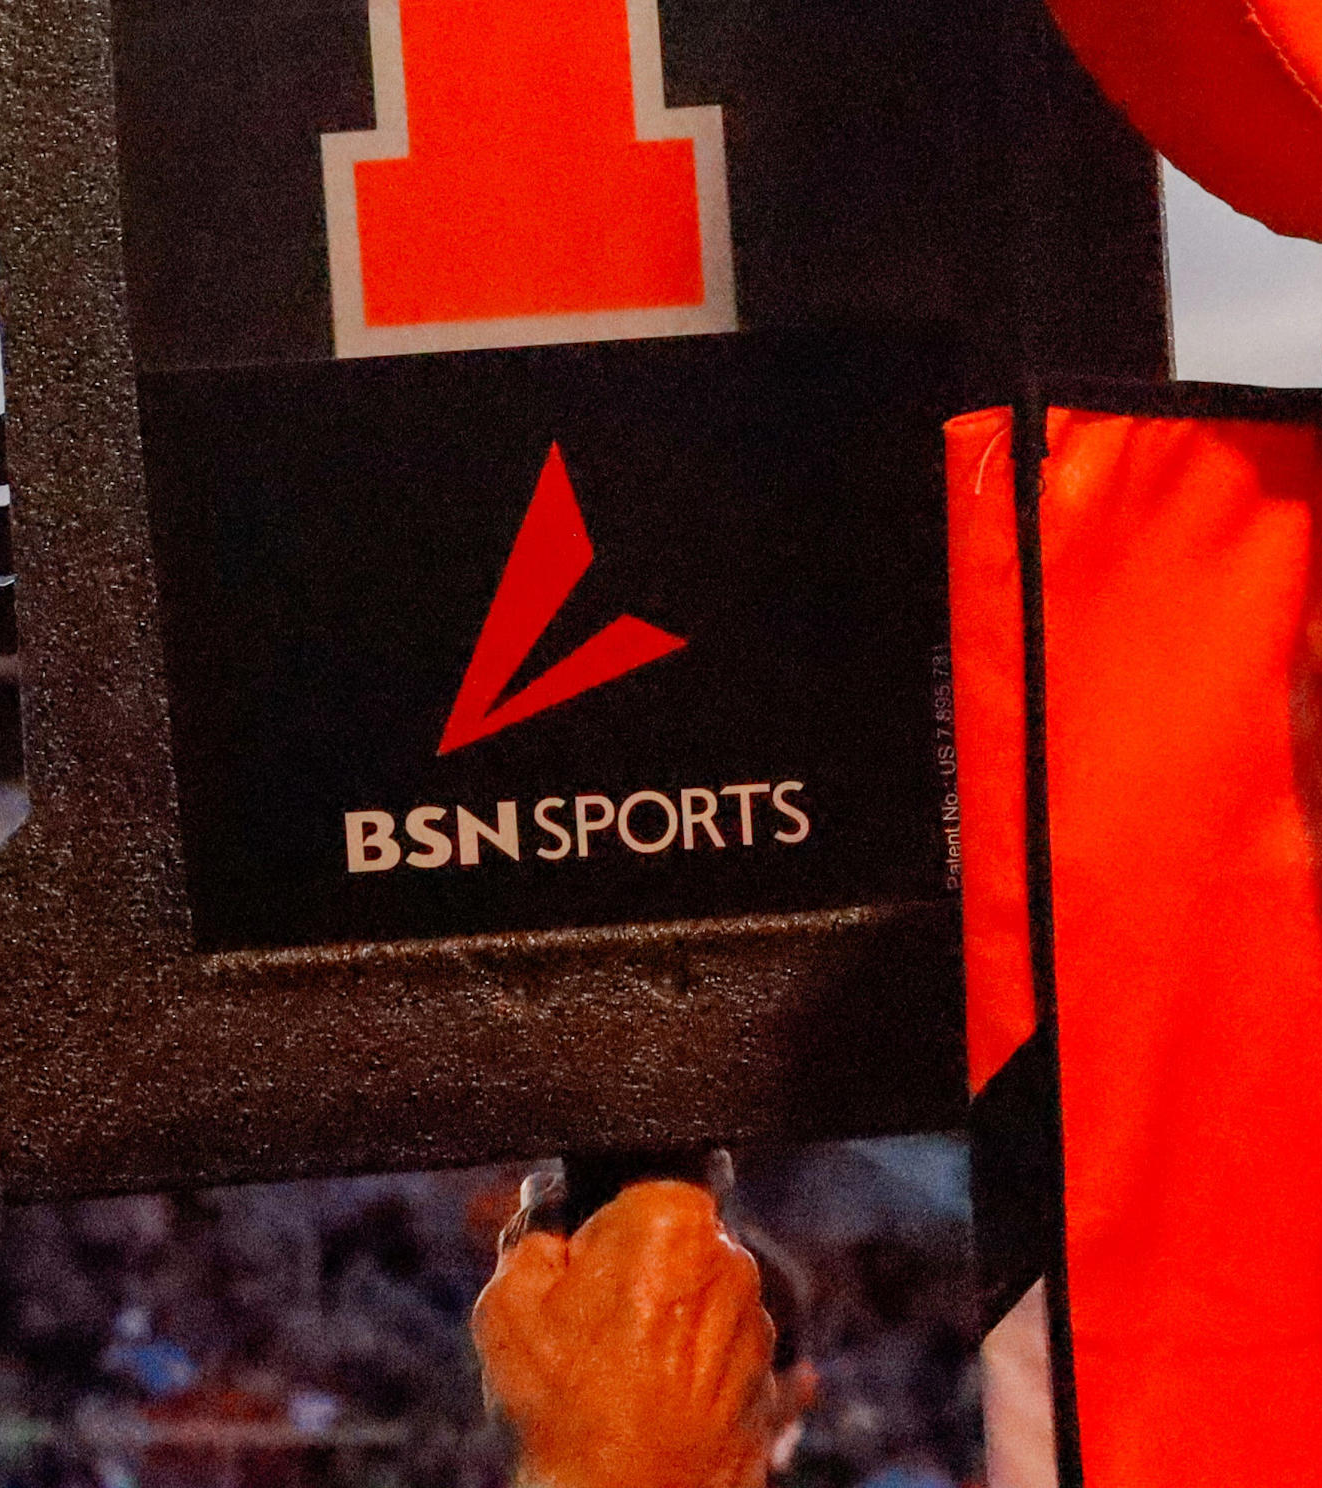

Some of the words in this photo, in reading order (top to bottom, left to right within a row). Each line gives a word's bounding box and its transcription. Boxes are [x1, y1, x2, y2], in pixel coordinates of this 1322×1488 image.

[937, 745, 956, 775] US
[345, 801, 519, 873] BSN
[533, 781, 810, 861] SPORTS
[944, 826, 961, 889] Patent
